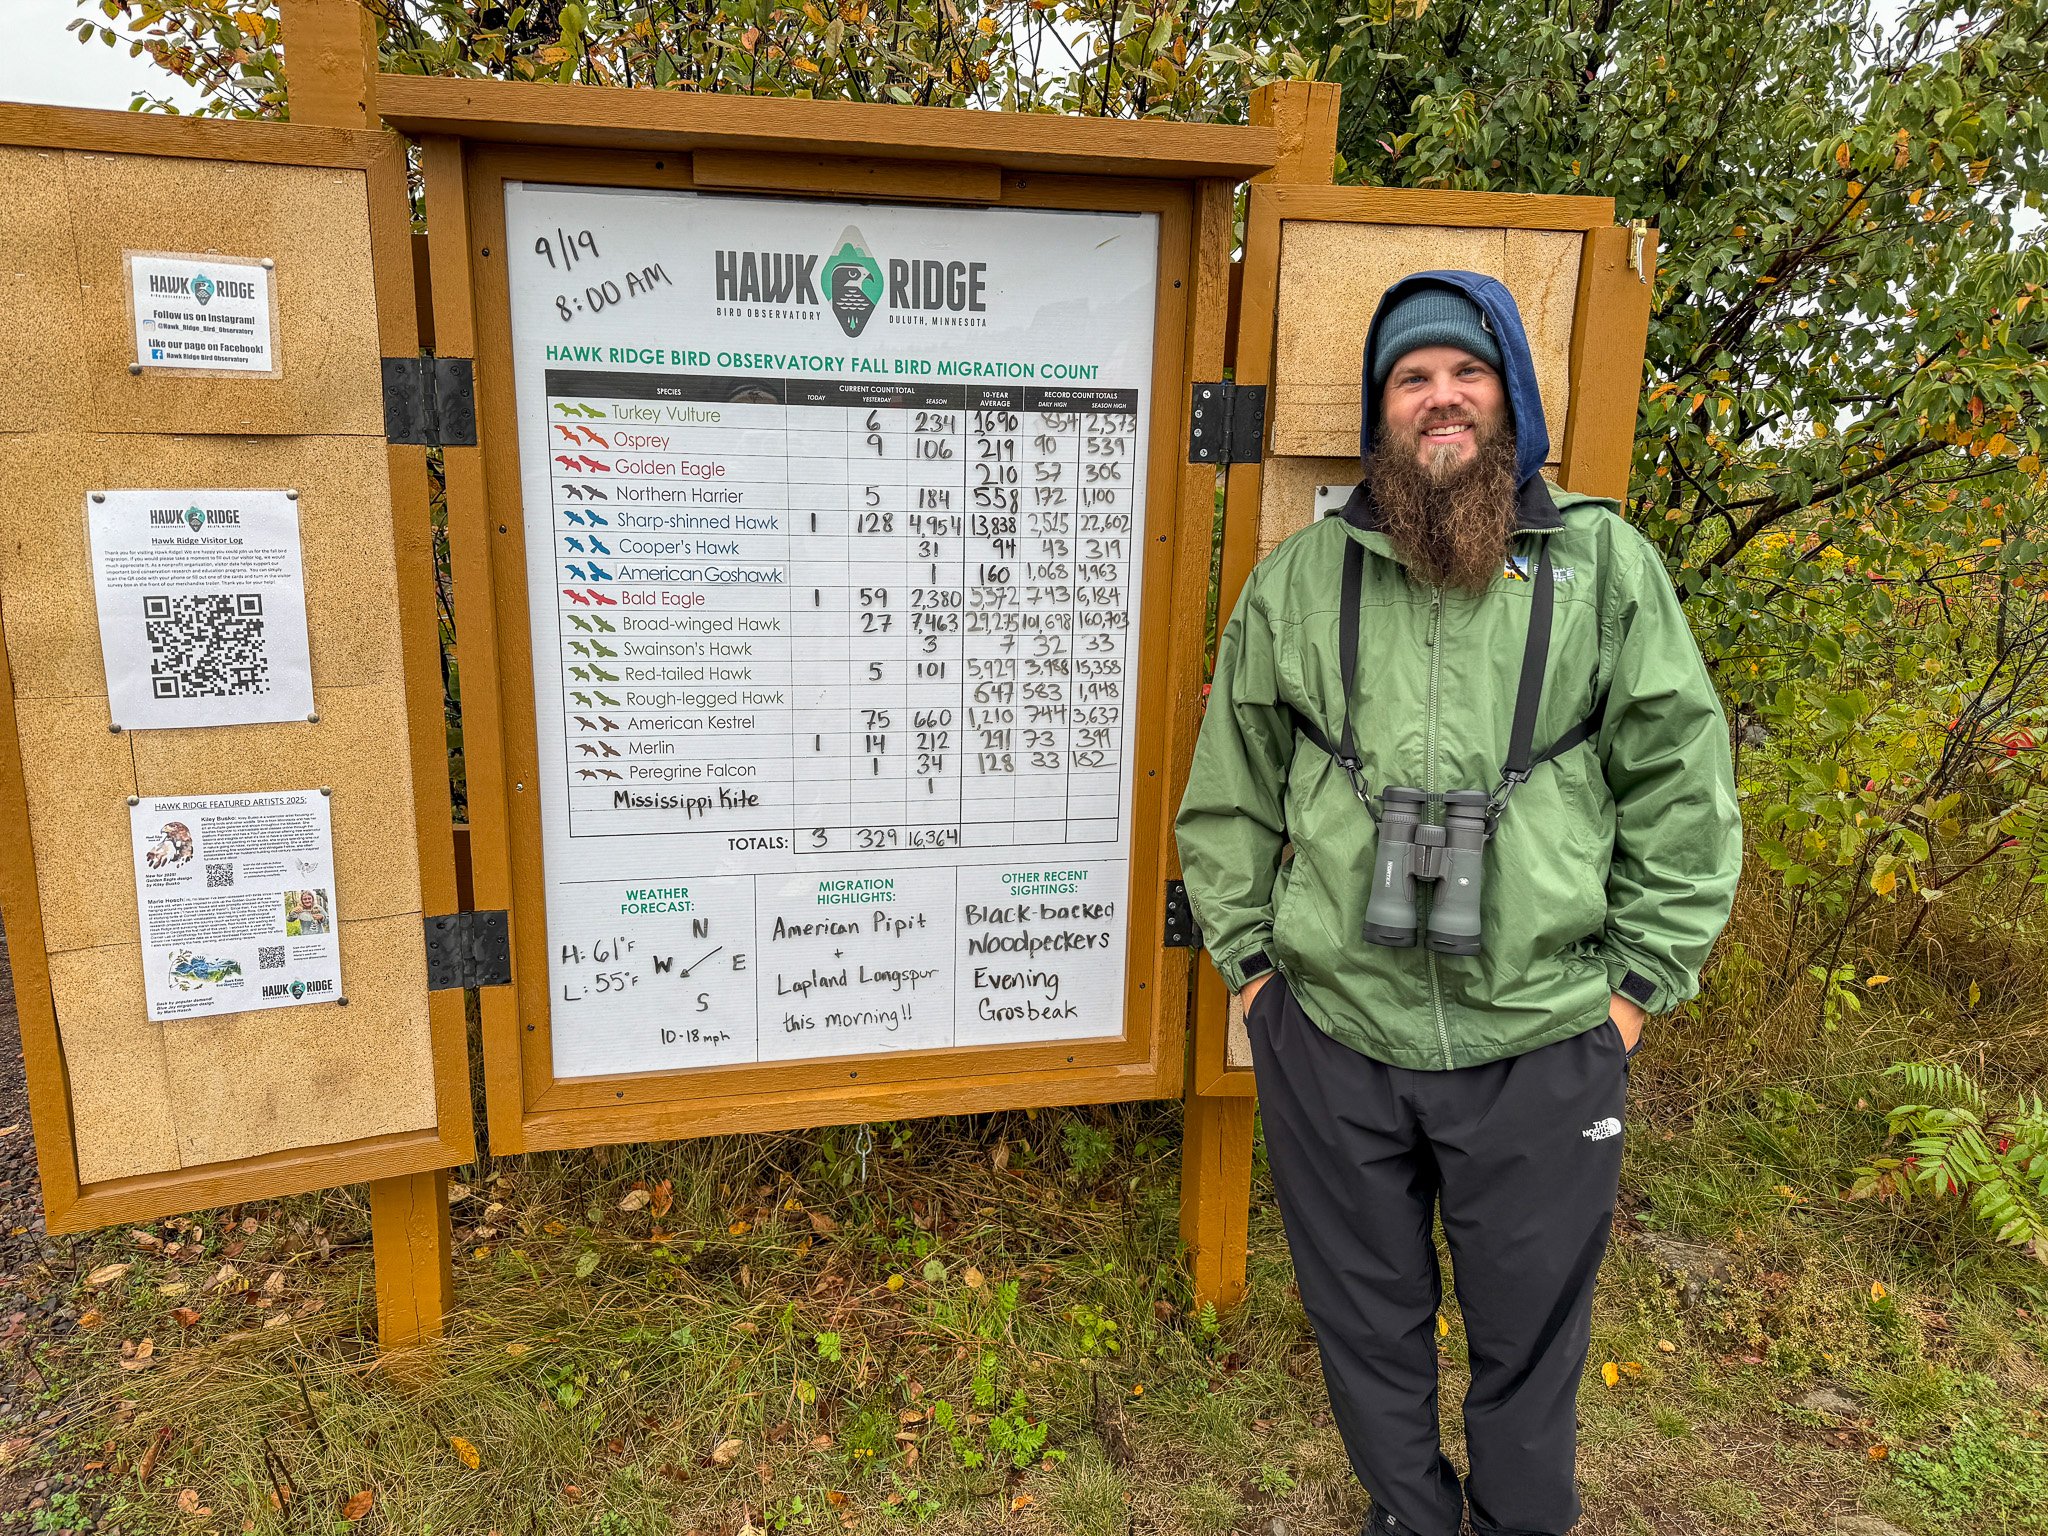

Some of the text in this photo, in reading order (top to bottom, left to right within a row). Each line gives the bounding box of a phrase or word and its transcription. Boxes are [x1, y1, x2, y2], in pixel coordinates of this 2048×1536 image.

[535, 228, 599, 271] 9/19
[149, 274, 256, 299] HAWK RIDGE
[715, 250, 987, 312] HAWK RIDGE
[555, 263, 672, 321] 8:00 AM
[153, 309, 255, 325] Follow us on Instagram!
[716, 307, 821, 321] BIRD OBSERVATORY
[889, 314, 987, 327] DULUTH, MINNESOTA
[148, 338, 264, 354] Like our page on Facebook!
[183, 353, 200, 361] Ridge
[200, 353, 213, 361] Bird
[213, 355, 249, 364] Observatory
[546, 345, 1099, 380] HAWK RIDGE BIRD OBSERVATORY FALL BIRD MIGRATION COUNT
[656, 387, 682, 396] SPECIES
[839, 384, 915, 394] CURRENT COUNT TOTAL
[982, 391, 1009, 399] 10-YEAR
[1044, 391, 1071, 399] RECORD
[1095, 392, 1118, 400] TOTALS
[979, 400, 1011, 408] AVERAGE
[612, 404, 721, 424] Turkey Vulture
[613, 431, 670, 451] Osprey
[915, 437, 953, 460] 106
[977, 438, 1015, 461] 219
[615, 458, 726, 479] Golden Eagle
[975, 463, 1018, 485] 210
[1086, 461, 1121, 482] 306
[616, 486, 743, 503] Northern Harrier
[919, 488, 950, 509] 184
[149, 509, 240, 524] HAWK RIDGE
[617, 512, 779, 531] Sharp-shinned Hawk
[857, 512, 894, 533] 128
[177, 537, 199, 545] Ridge
[229, 537, 243, 545] Log
[619, 538, 740, 557] Cooper's Hawk
[1042, 538, 1069, 558] 43
[1085, 539, 1121, 559] 319
[618, 565, 783, 583] American Goshawk
[980, 563, 1010, 585] 160
[622, 591, 705, 609] Bald Eagle
[860, 588, 888, 608] 59
[1026, 586, 1071, 605] 743
[623, 616, 781, 635] Broad-winged Hawk
[860, 612, 892, 633] 27
[623, 641, 753, 656] Swainson's Hawk
[1033, 635, 1067, 656] 32
[625, 666, 752, 681] Red-tailed Hawk
[917, 662, 945, 679] 101
[626, 690, 785, 710] Rough-legged Hawk
[1023, 683, 1062, 701] 583
[627, 715, 755, 730] American Kestrel
[861, 709, 891, 730] 75
[914, 709, 952, 728] 660
[629, 741, 675, 754] Merlin
[917, 731, 950, 752] 212
[1023, 729, 1055, 748] 73
[1076, 728, 1111, 748] 399
[916, 753, 943, 775] 34
[978, 753, 1014, 774] 128
[1031, 752, 1060, 768] 33
[629, 763, 756, 781] Peregrine Falcon
[154, 796, 307, 811] HAWK RIDGE FEATURED ARTISTS 2025:
[613, 786, 760, 820] Mississippi Kite
[728, 836, 789, 851] TOTALS:
[857, 828, 897, 848] 329
[818, 879, 894, 892] MIGRATION
[1001, 870, 1089, 884] OTHER RECENT
[625, 887, 689, 901] WEATHER
[817, 892, 896, 905] HIGHLIGHTS:
[1010, 883, 1078, 896] SIGHTINGS:
[621, 901, 695, 914] FORECAST:
[965, 901, 1114, 926] Black-backed
[692, 917, 709, 939] N
[772, 910, 927, 942] American Pipit
[968, 929, 1110, 958] Woodpeckers
[562, 944, 586, 965] H:
[732, 954, 746, 971] E
[653, 955, 673, 975] W
[262, 979, 333, 997] HAWK RIDGE
[777, 965, 940, 998] Lapland Longspur
[974, 966, 1059, 1000] Evening
[564, 985, 588, 1001] L:
[696, 992, 709, 1012] S
[783, 1002, 913, 1033] this morning!!
[978, 997, 1078, 1021] Grosbeak
[661, 1028, 731, 1047] 10-18 mph
[1582, 1127, 1610, 1137] NORTH
[1593, 1120, 1608, 1129] THE
[1591, 1131, 1611, 1142] FACE
